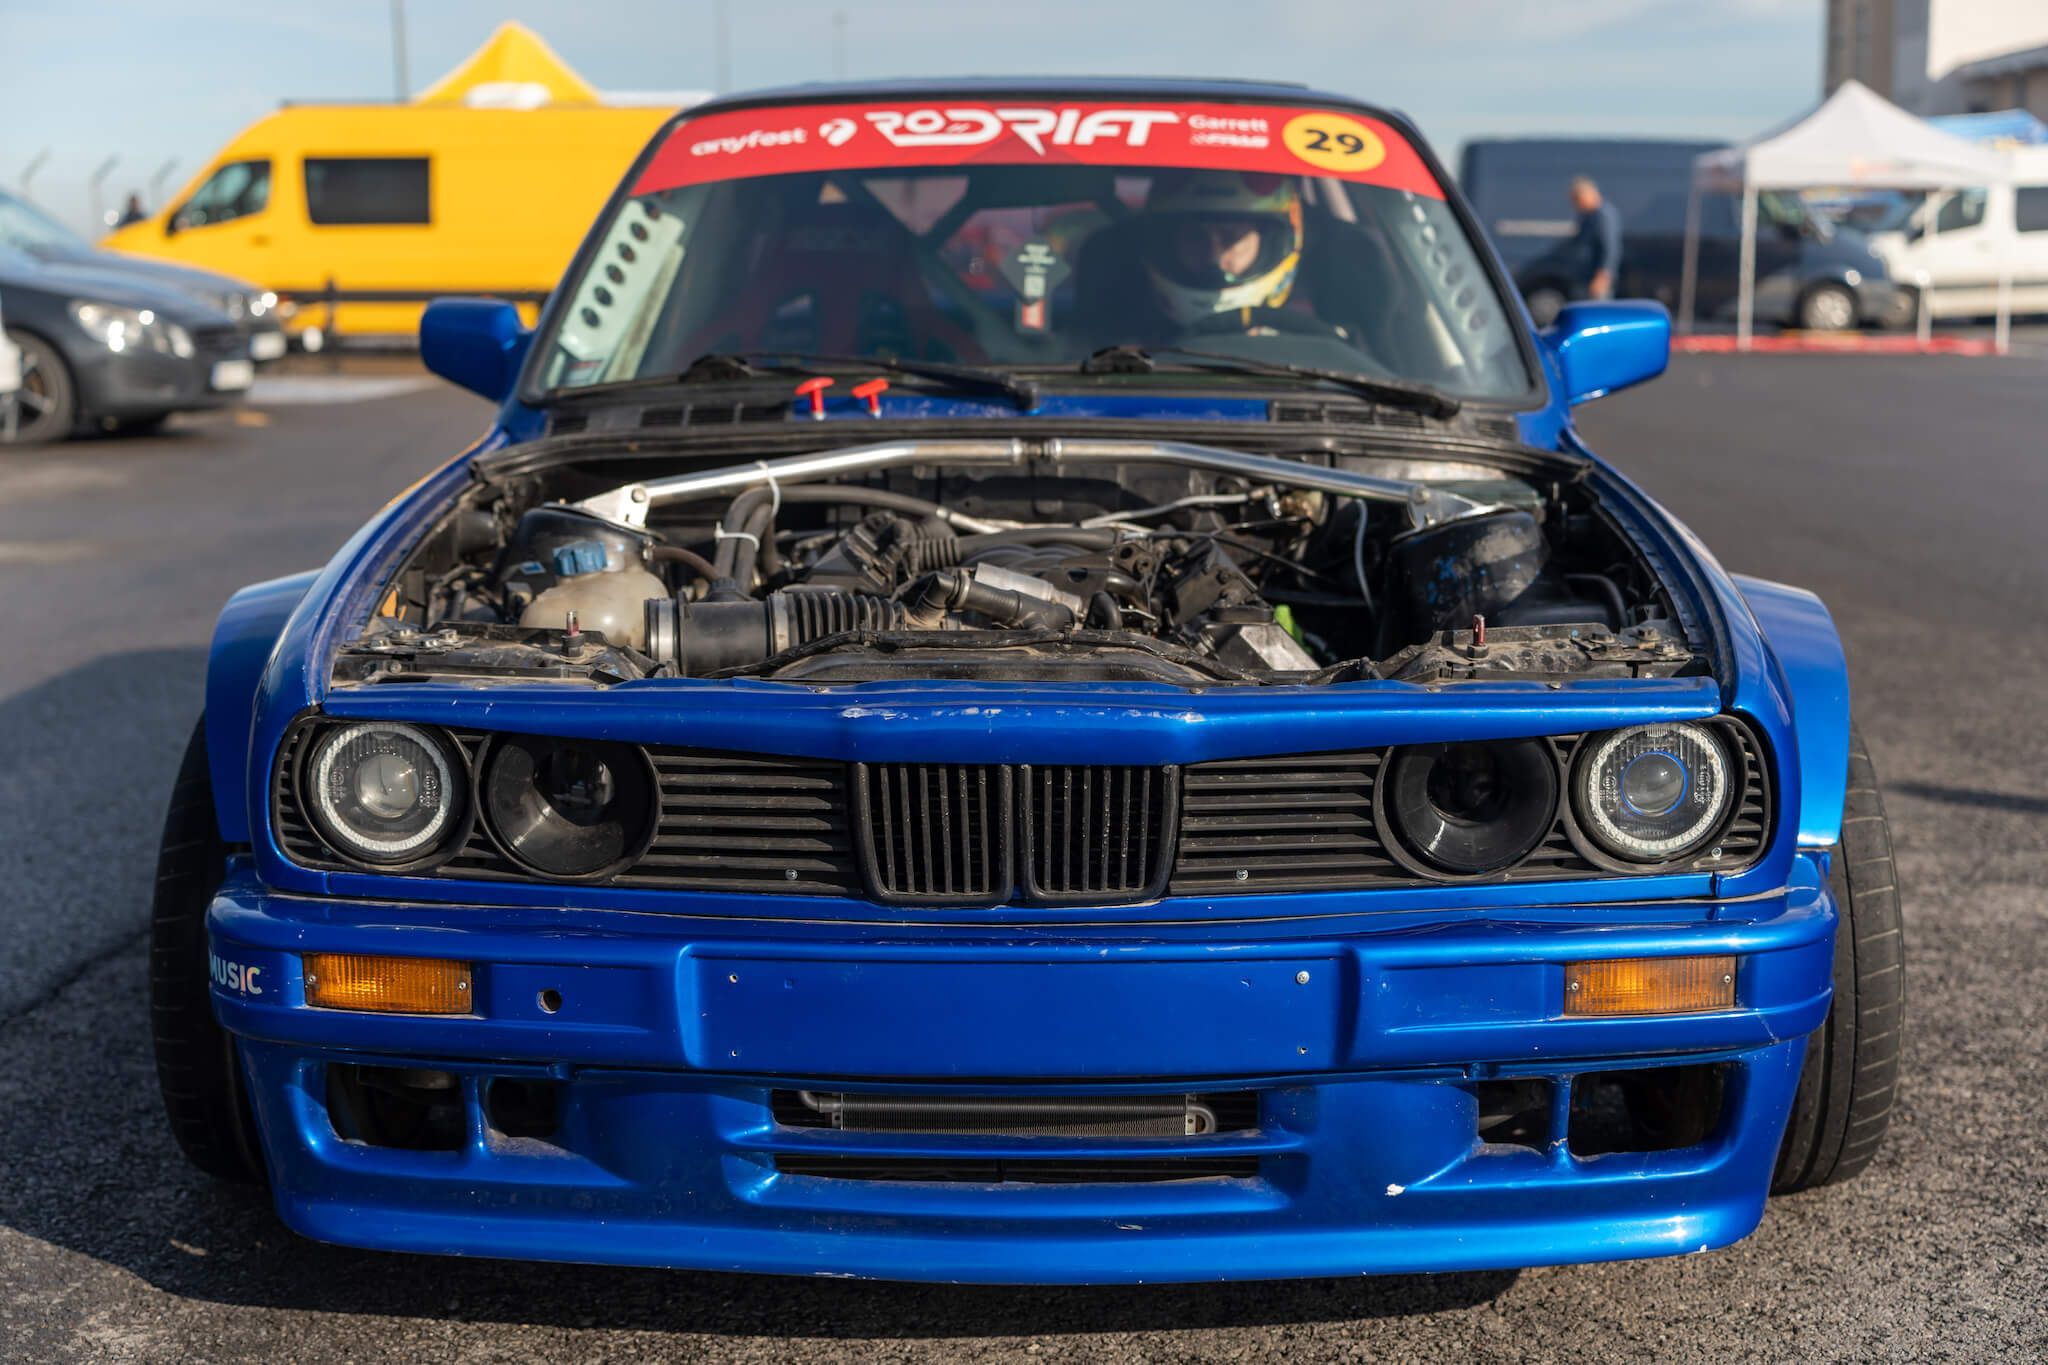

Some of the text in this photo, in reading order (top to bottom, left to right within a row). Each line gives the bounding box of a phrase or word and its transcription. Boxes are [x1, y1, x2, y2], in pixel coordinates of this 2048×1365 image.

[1188, 114, 1268, 132] Garrett
[1305, 127, 1364, 155] 29
[209, 953, 262, 994] MUSIC
